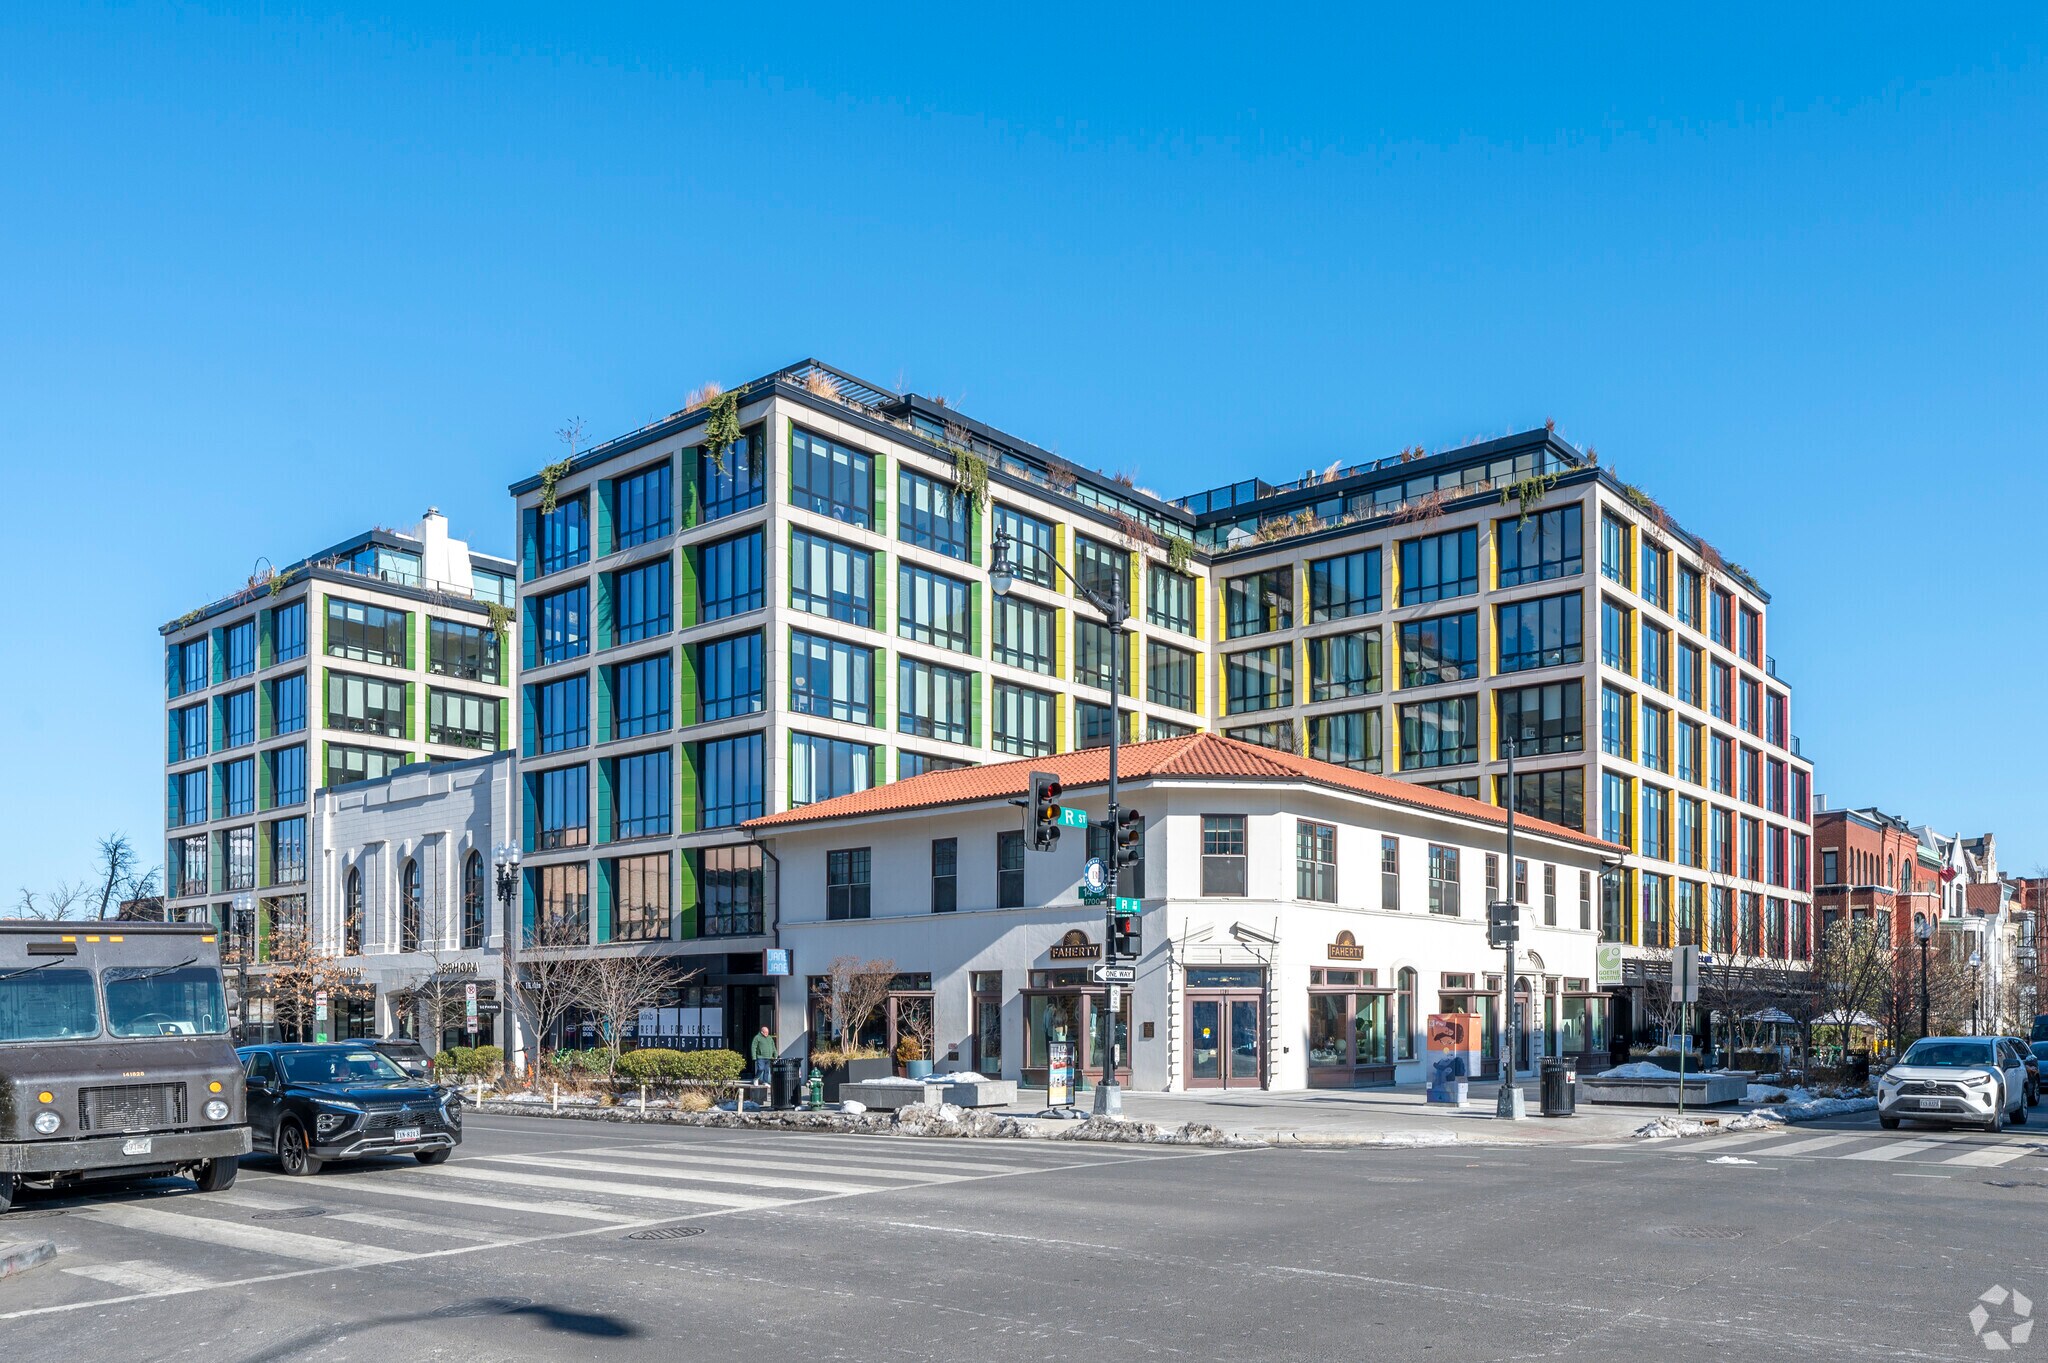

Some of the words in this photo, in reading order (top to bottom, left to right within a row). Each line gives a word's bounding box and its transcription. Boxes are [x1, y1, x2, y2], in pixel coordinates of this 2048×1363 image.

[1065, 809, 1074, 825] R
[1078, 814, 1086, 824] ST
[1121, 899, 1128, 909] R
[769, 951, 788, 962] JANE
[1052, 946, 1099, 958] FAHERTY
[1331, 946, 1363, 957] FAHERTY
[438, 961, 480, 974] SEPHORA
[769, 962, 788, 973] JANE
[1105, 970, 1117, 978] ONE
[1119, 970, 1131, 978] WAY
[640, 1024, 666, 1035] RETAIL
[670, 1024, 684, 1035] FOR
[687, 1024, 710, 1035] LEASE
